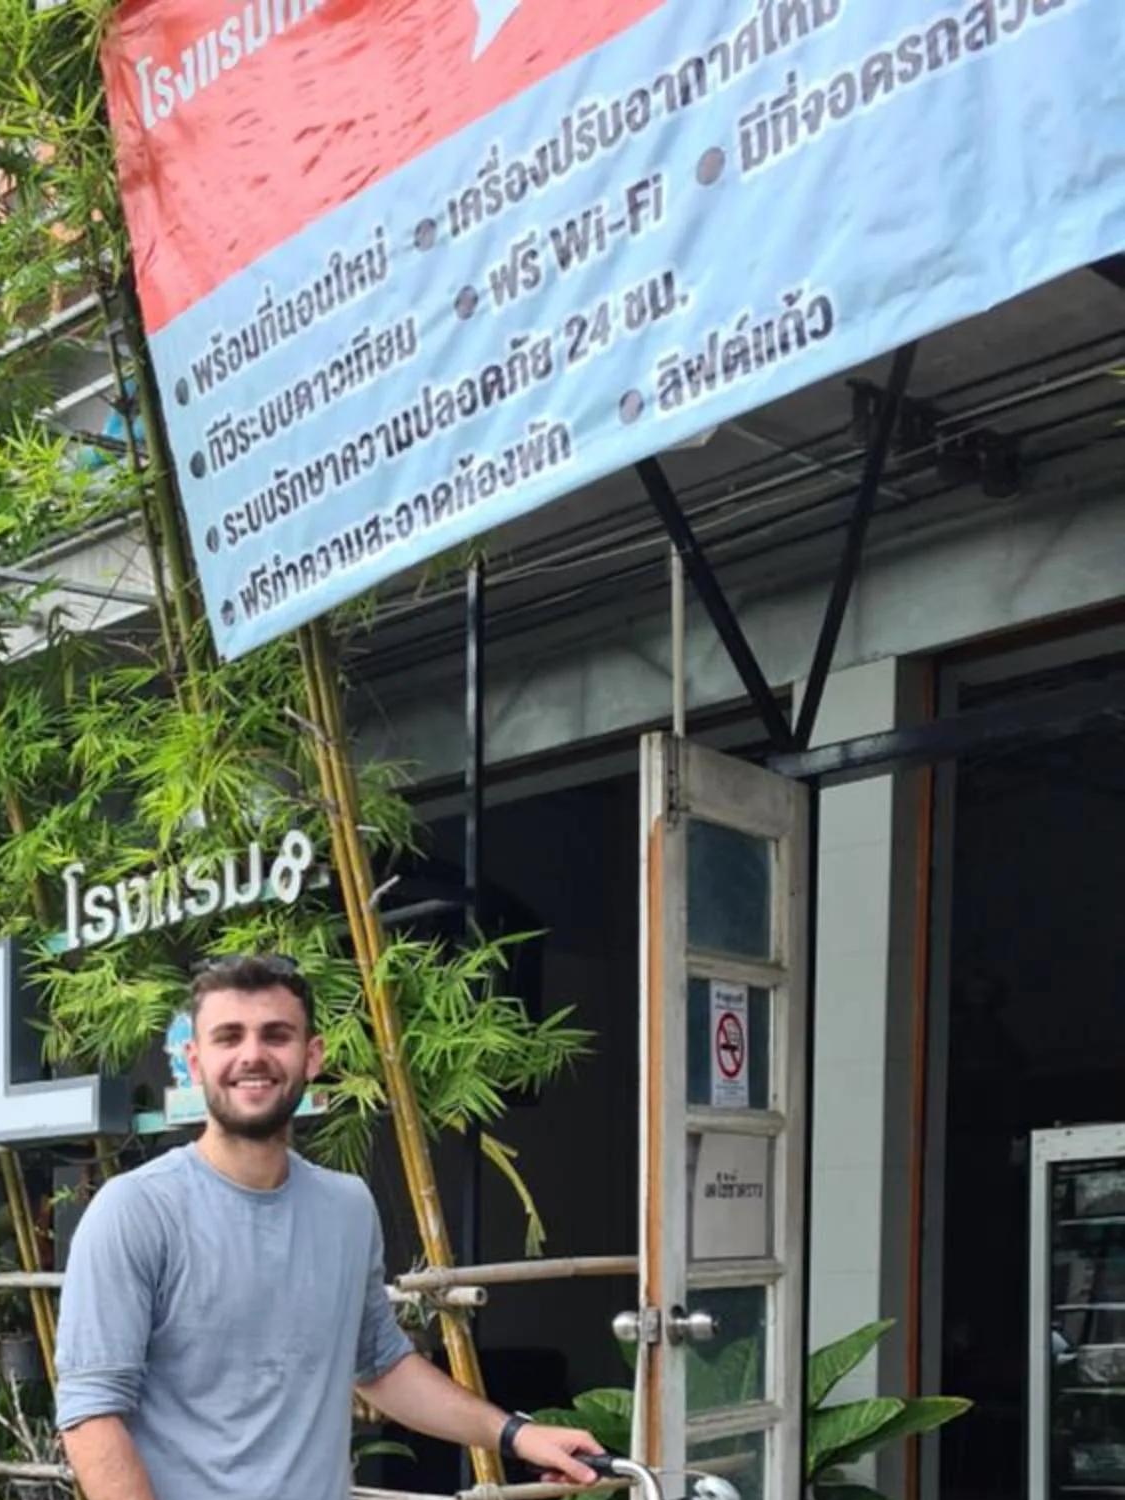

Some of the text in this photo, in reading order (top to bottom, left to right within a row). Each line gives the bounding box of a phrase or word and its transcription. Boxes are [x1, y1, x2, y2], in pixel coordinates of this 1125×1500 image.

[136, 0, 324, 129] โรงแรม
[191, 227, 390, 394] พร้อมที่นอนใหม่
[489, 175, 665, 307] ฟรี Wi-Fi
[207, 318, 418, 475] ทีวีระบบดาวเทียม
[222, 271, 690, 547] ระบบรักษาความปลอดภัย 24 ชม.
[655, 291, 834, 404] ลิฟต์แก้ว
[239, 419, 573, 618] ฟรีทำความสะอาดห้องพัก
